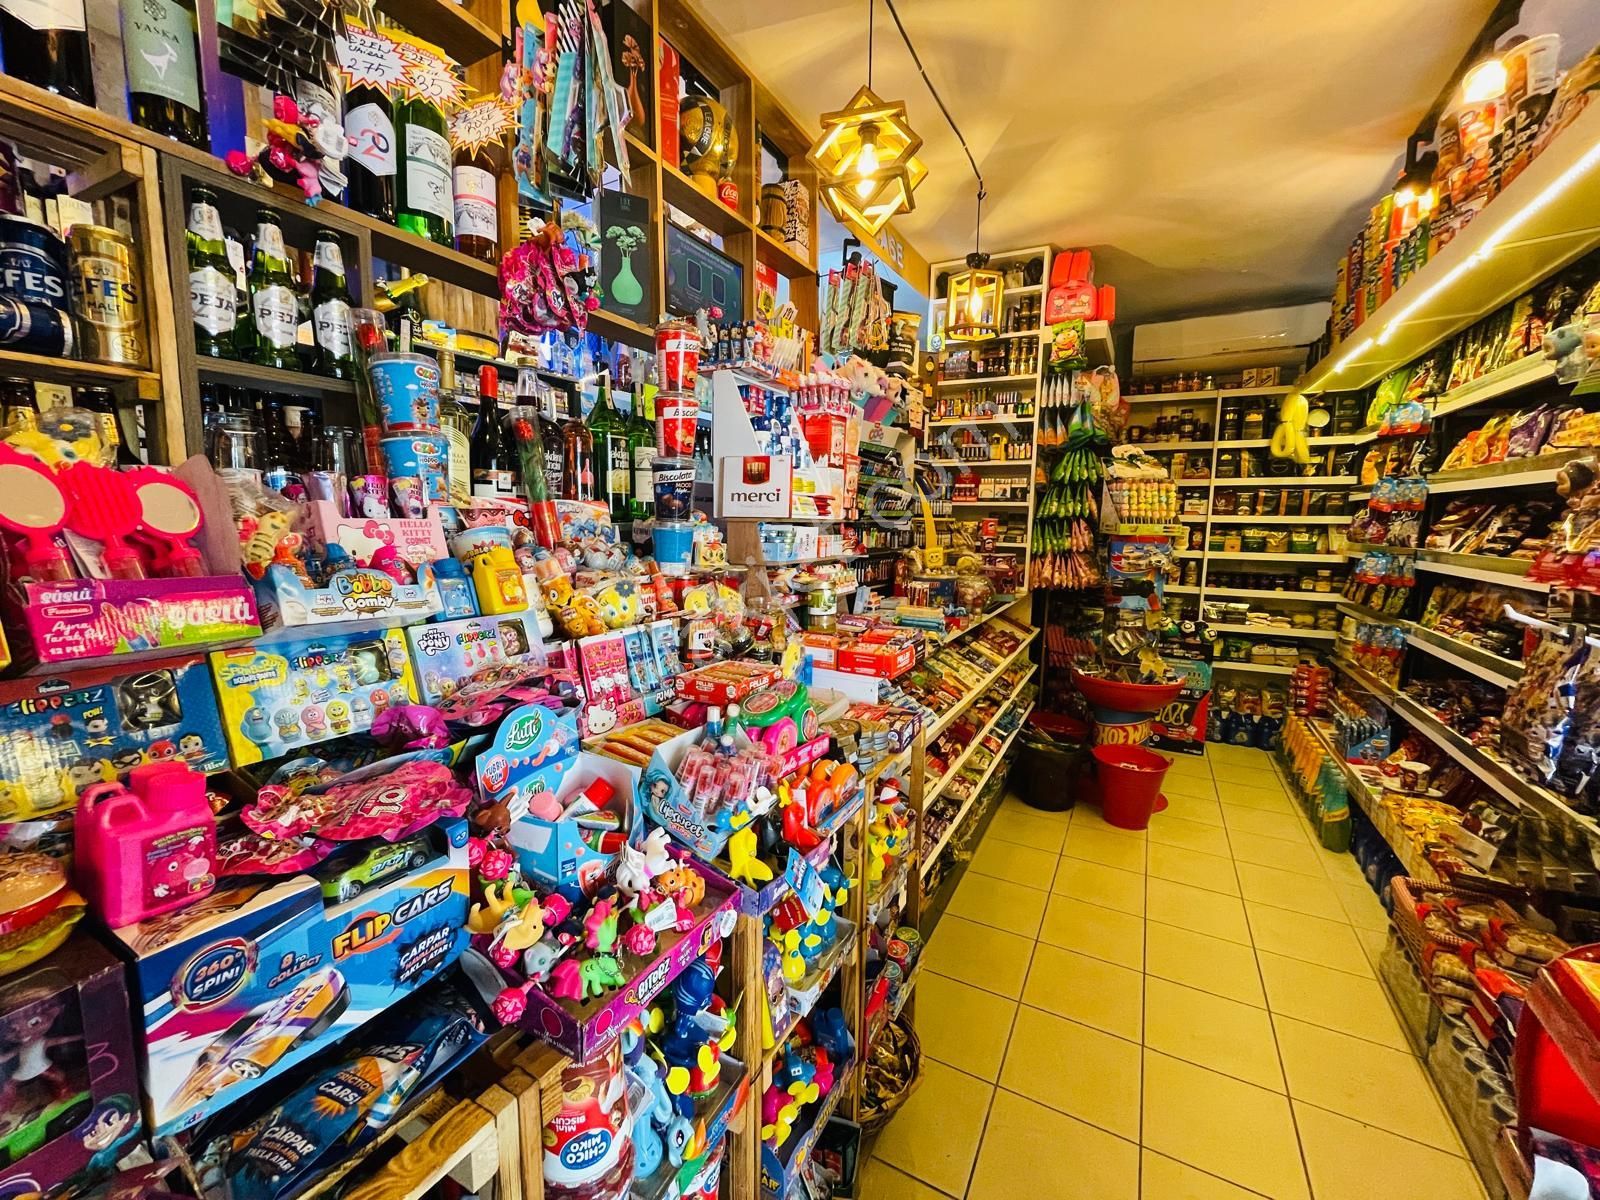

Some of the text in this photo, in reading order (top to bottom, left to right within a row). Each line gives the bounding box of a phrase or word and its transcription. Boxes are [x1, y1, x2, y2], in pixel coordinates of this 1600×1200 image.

[134, 21, 180, 44] VASKA
[346, 58, 393, 77] 275
[699, 111, 714, 145] LEAGUE
[88, 301, 121, 314] MALT
[731, 487, 781, 503] merci
[402, 529, 432, 537] KITTY
[337, 573, 393, 595] Bobbo
[343, 595, 394, 612] Bomby
[417, 637, 451, 656] PONY
[506, 710, 542, 751] Lutti
[331, 877, 455, 960] FLIP CARS
[400, 927, 450, 965] CARPAR
[194, 951, 241, 983] 360°
[268, 954, 322, 988] COLLECT
[281, 952, 308, 970] 8 TO
[191, 966, 239, 999] SPIN!
[319, 1082, 361, 1105] CARS!
[263, 1126, 315, 1156] CARPAR
[570, 1134, 601, 1151] MIKO
[566, 1142, 606, 1164] CHICO
